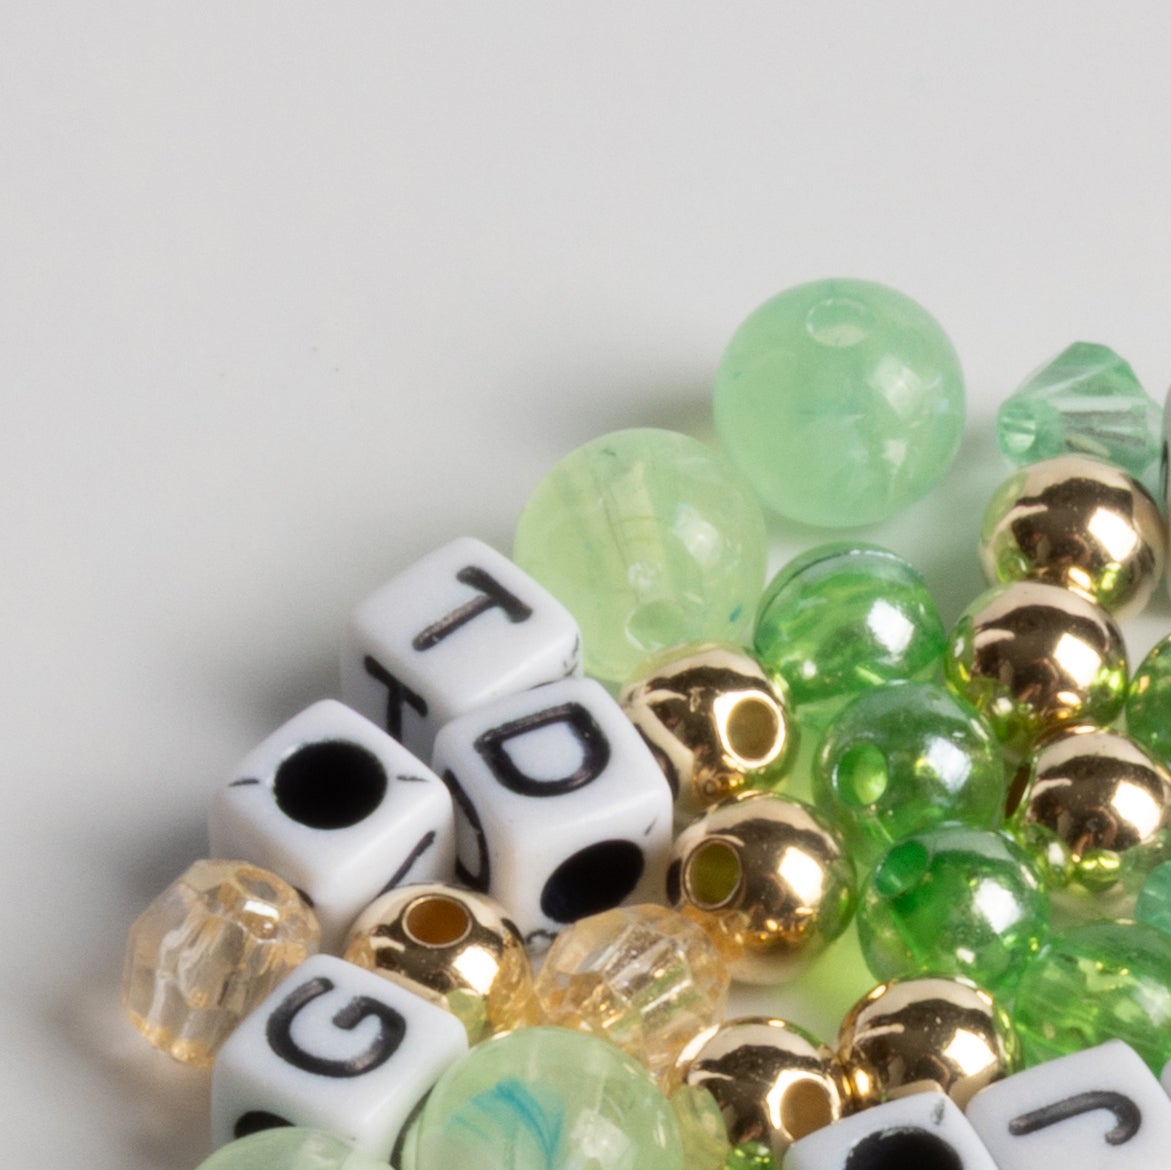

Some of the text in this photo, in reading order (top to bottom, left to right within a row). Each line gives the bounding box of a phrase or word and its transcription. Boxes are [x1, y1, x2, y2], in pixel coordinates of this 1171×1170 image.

[412, 566, 532, 652] T
[473, 702, 611, 798] D
[266, 977, 407, 1078] G
[1009, 1090, 1142, 1146] J
